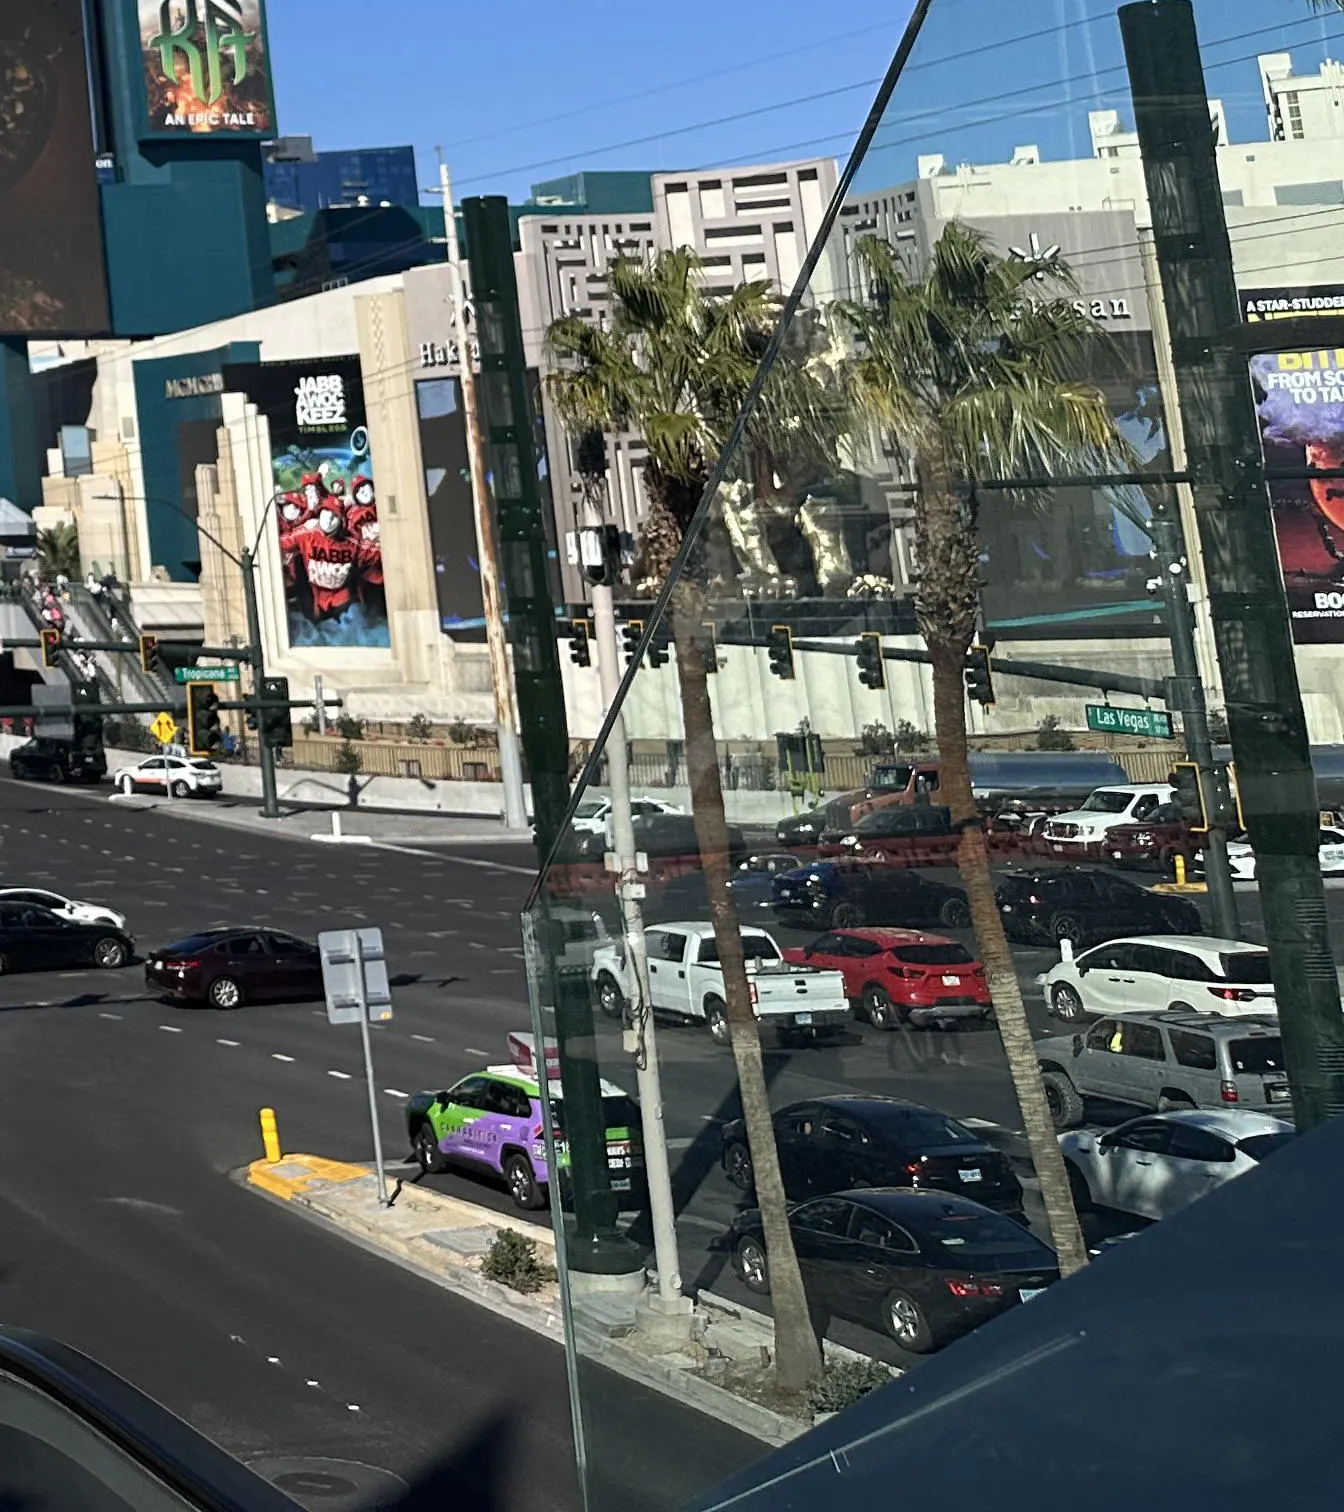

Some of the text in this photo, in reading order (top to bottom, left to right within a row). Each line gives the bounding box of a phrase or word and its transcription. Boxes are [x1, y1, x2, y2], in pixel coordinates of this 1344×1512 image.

[164, 112, 255, 126] AN EPIC TALE
[1246, 300, 1256, 312] A
[294, 375, 344, 396] JABB
[1267, 370, 1322, 389] FROM
[297, 391, 346, 409] AWOC
[1289, 387, 1318, 404] TO
[297, 404, 349, 426] KEEZ
[1314, 591, 1344, 609] BO
[182, 667, 225, 680] Tropicana
[1096, 707, 1116, 725] Las
[1116, 709, 1150, 733] Vegas
